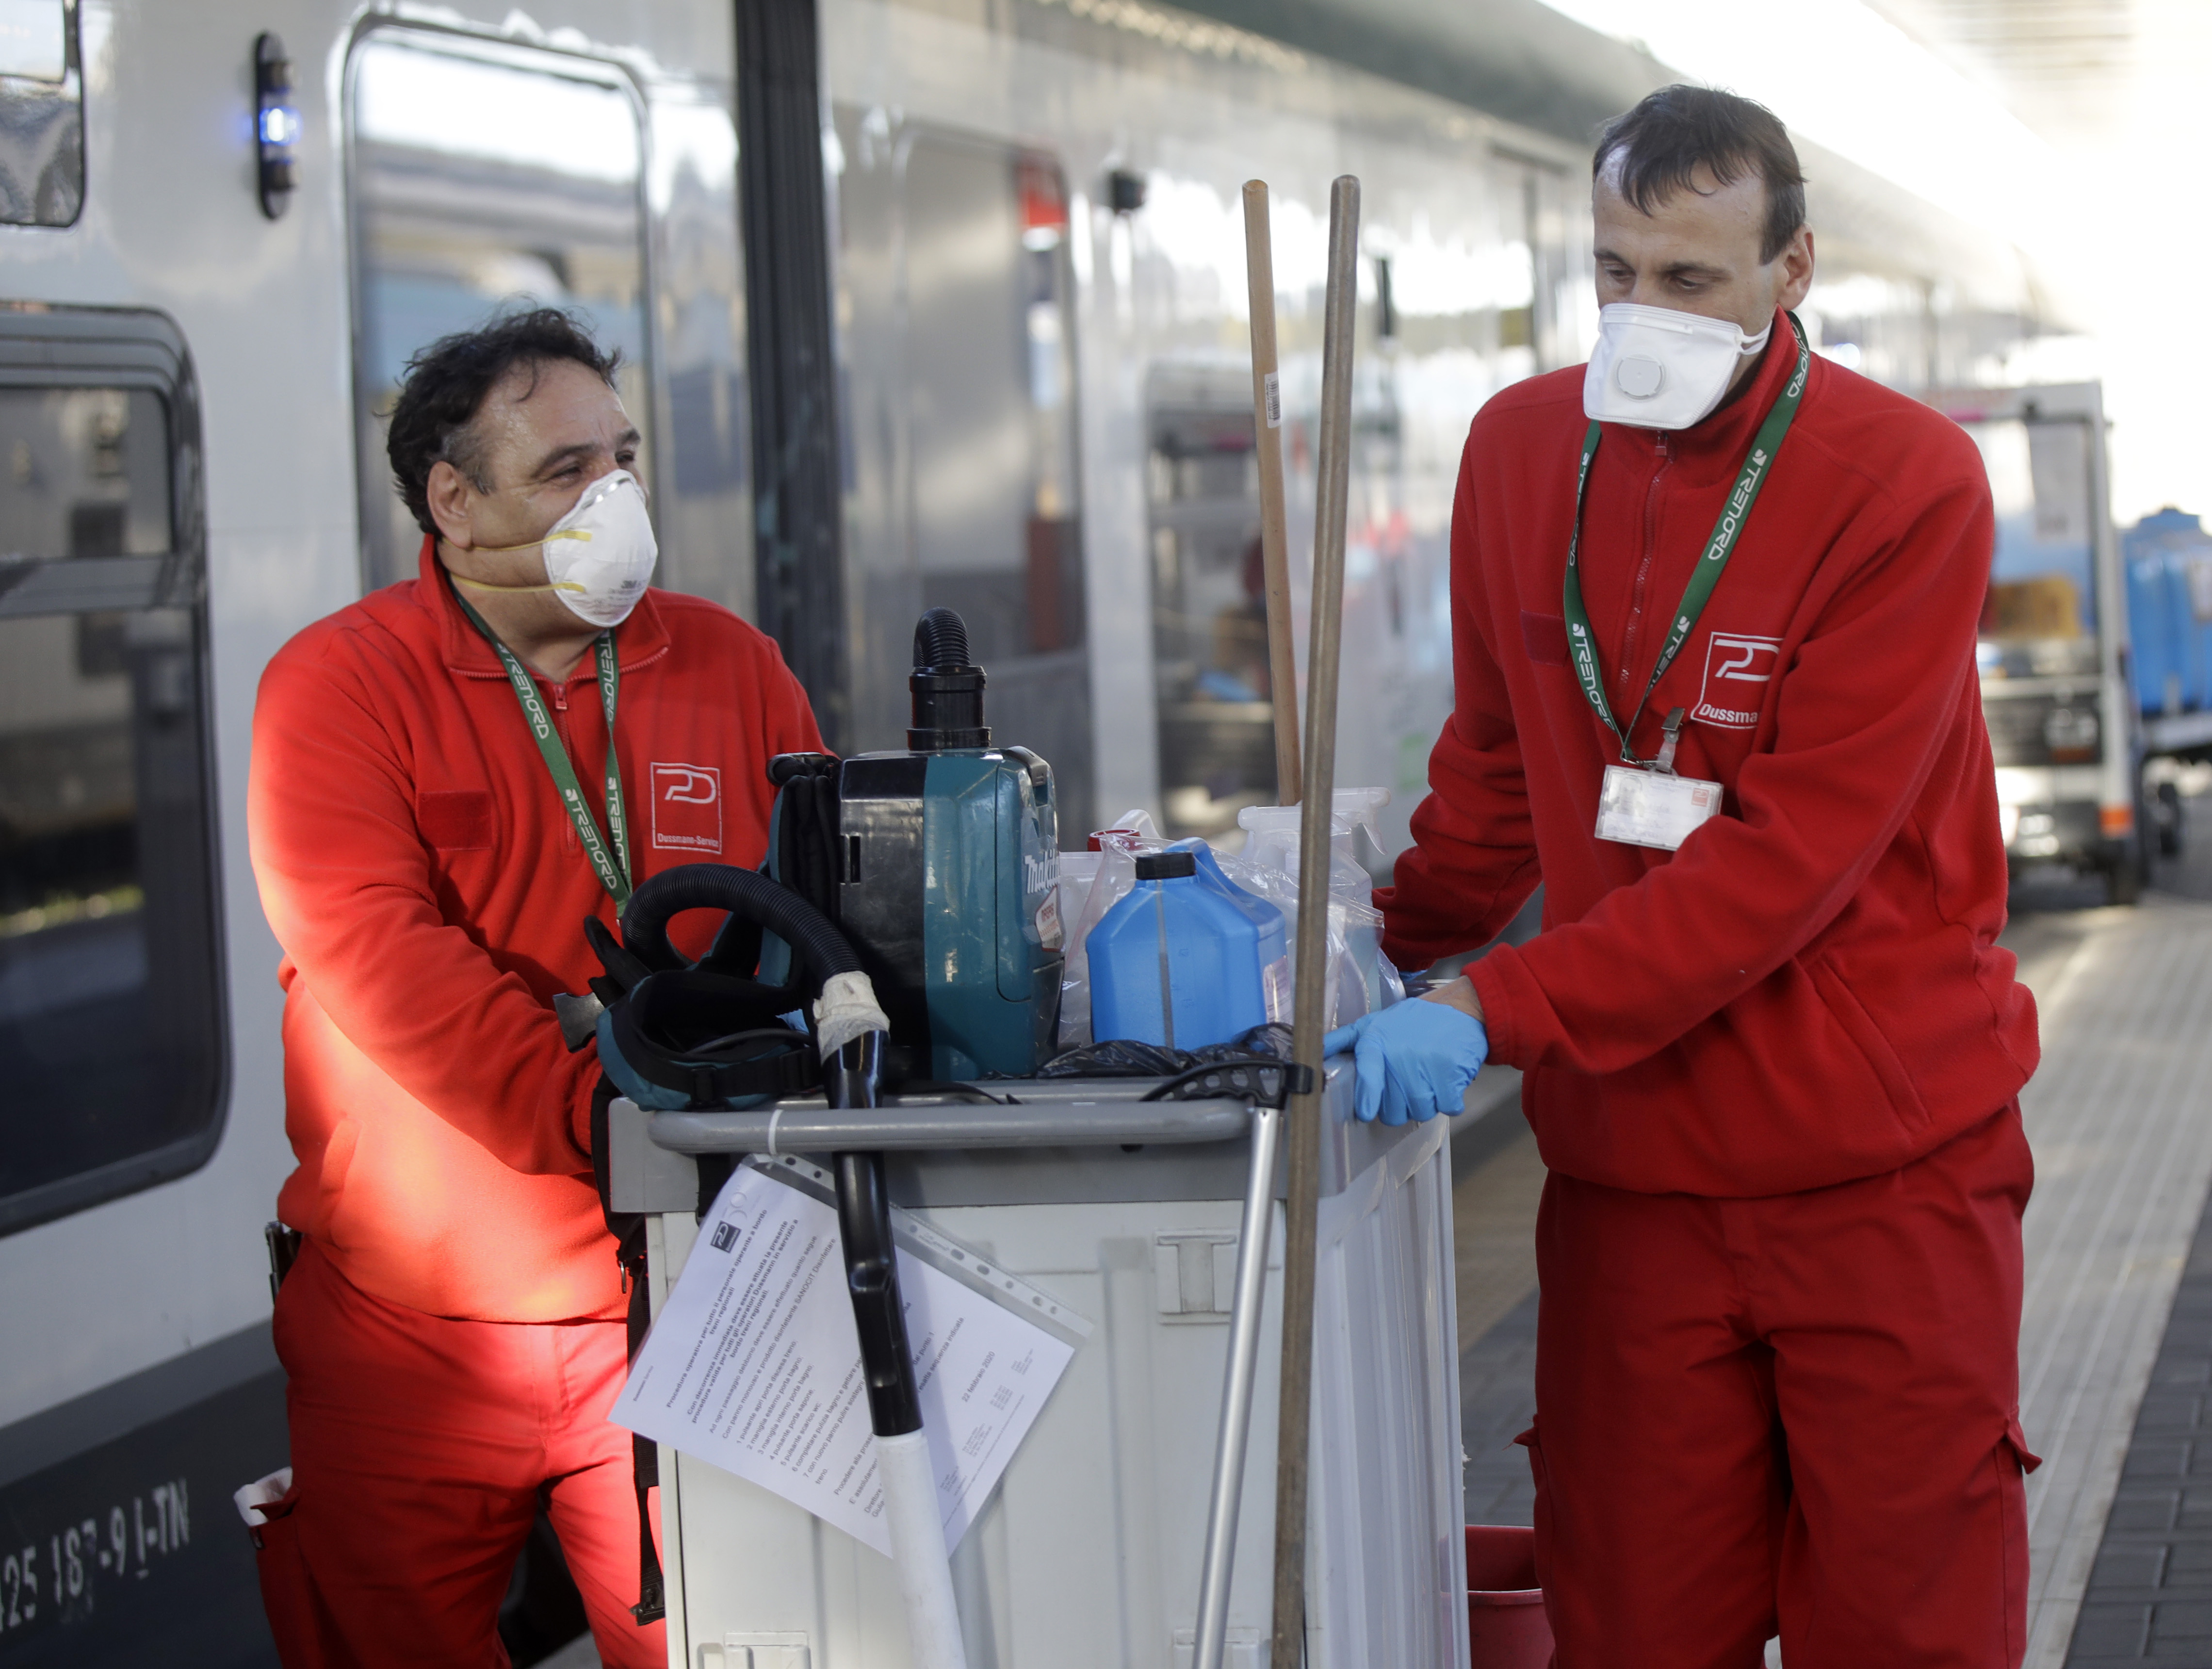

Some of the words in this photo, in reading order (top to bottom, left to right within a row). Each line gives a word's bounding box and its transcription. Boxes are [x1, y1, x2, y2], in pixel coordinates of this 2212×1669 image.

[1708, 466, 1761, 560] TRENORD
[505, 653, 549, 739] TRENORD
[600, 637, 615, 722] TRENORD
[1575, 638, 1615, 731] TRENORD
[1698, 704, 1761, 723] Dussma
[572, 801, 617, 889] TRENORD
[657, 833, 719, 847] Dussmann-Service
[725, 1227, 739, 1251] Dussmann
[967, 1368, 985, 1392] febbraio
[982, 1351, 995, 1367] 2020
